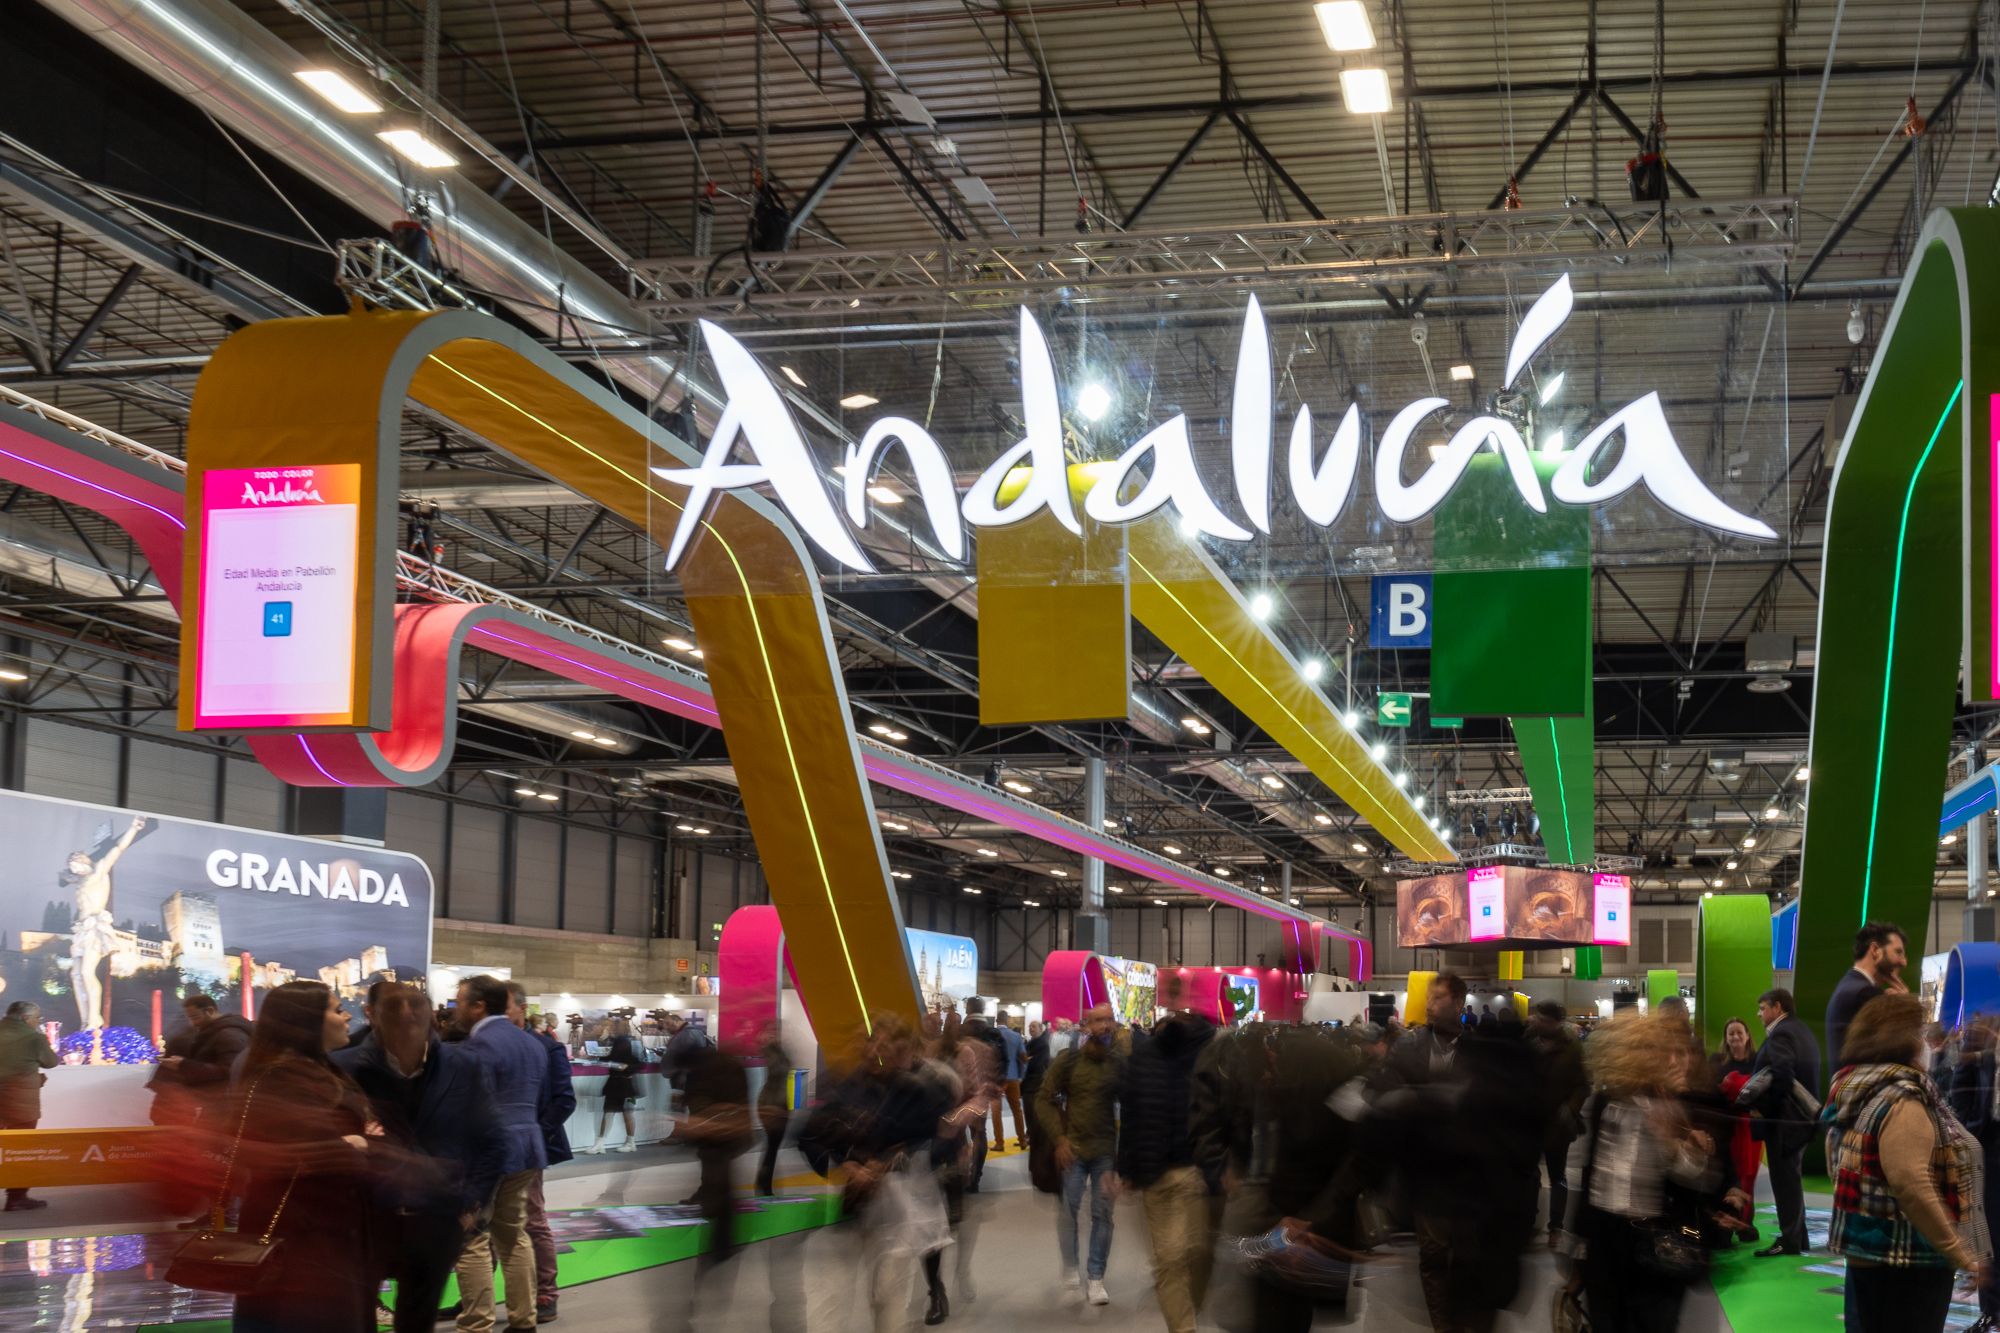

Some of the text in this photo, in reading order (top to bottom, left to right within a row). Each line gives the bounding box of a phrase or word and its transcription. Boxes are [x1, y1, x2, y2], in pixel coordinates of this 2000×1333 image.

[651, 274, 1776, 572] Andalucía
[241, 480, 325, 506] Andalucía
[224, 568, 248, 579] Edad
[251, 567, 279, 578] Media
[281, 568, 293, 577] en
[271, 613, 284, 624] 41
[1389, 583, 1427, 636] B
[206, 849, 410, 908] GRANADA
[946, 944, 974, 968] JAÉN
